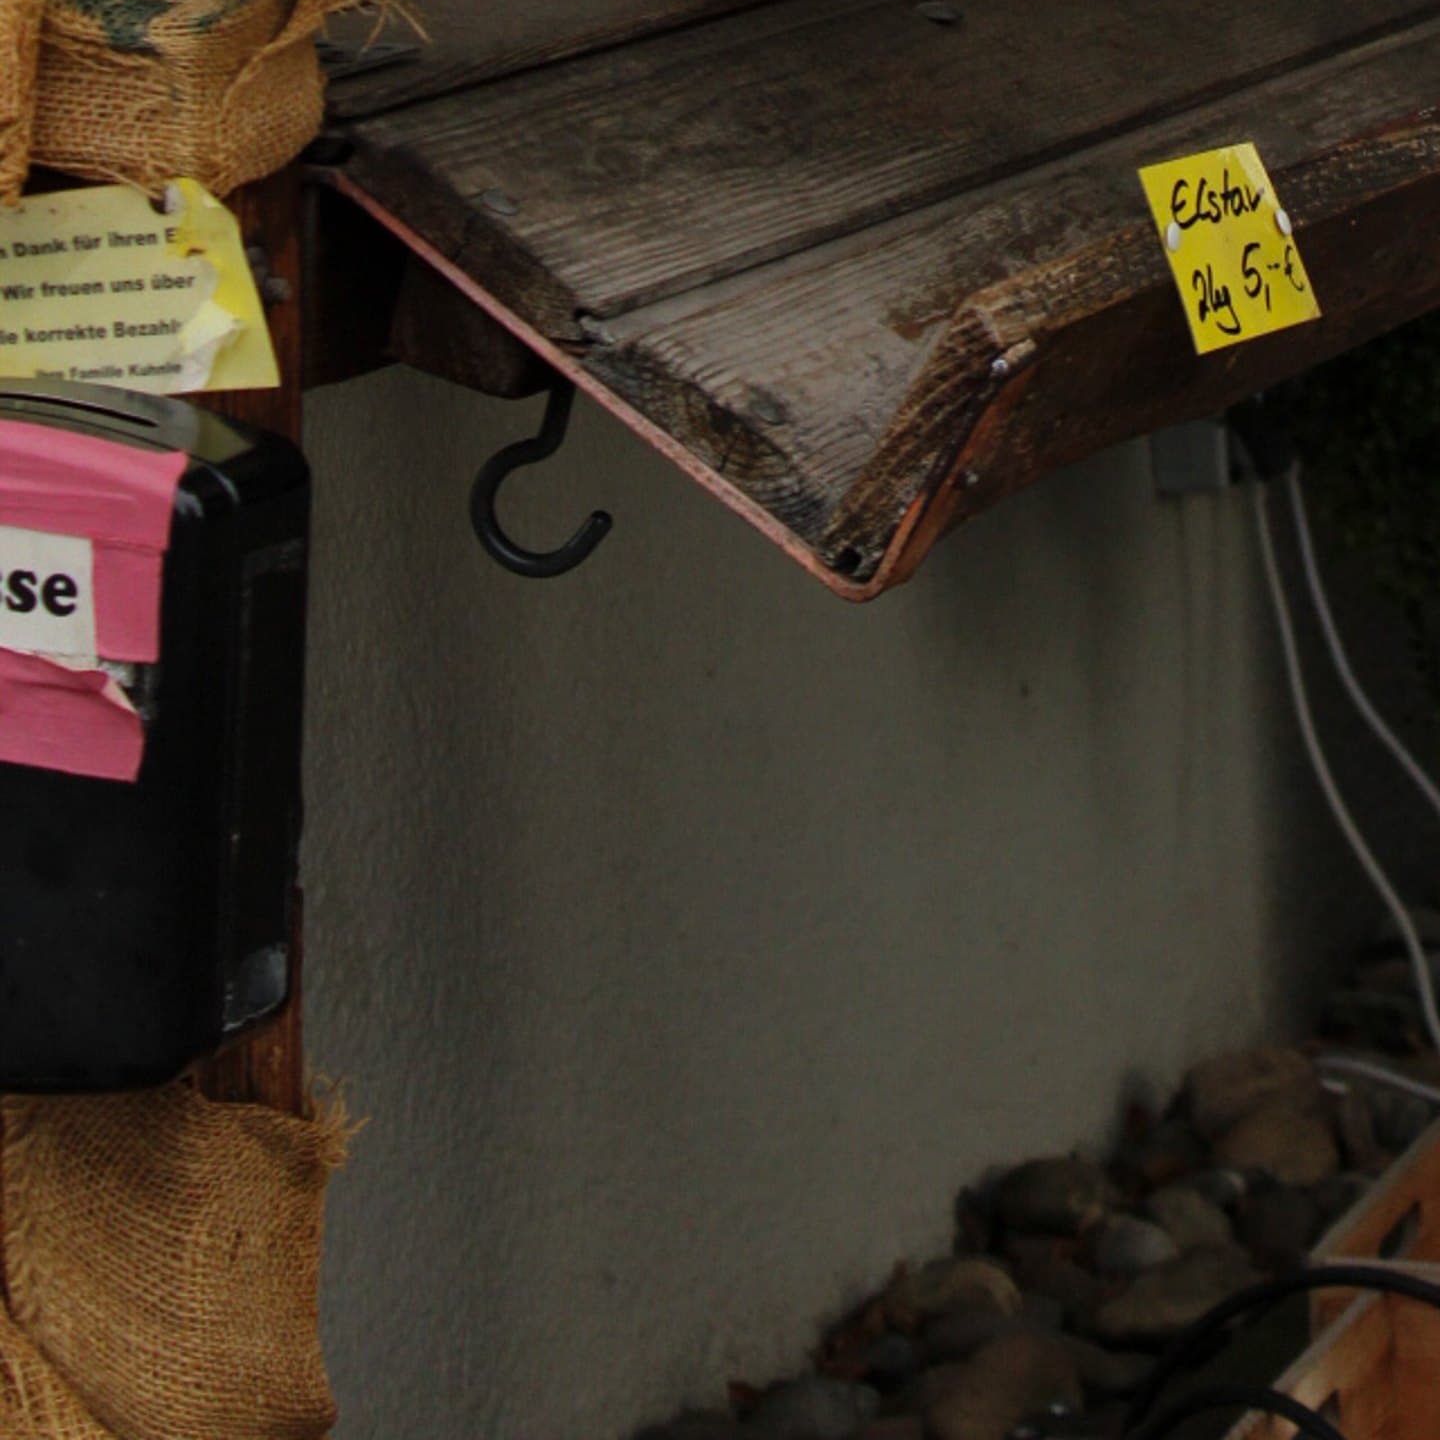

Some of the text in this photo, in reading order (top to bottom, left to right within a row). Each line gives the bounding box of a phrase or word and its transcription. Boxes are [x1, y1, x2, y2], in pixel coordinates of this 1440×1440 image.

[12, 239, 68, 257] Dank
[72, 234, 101, 251] für
[2, 273, 195, 300] Wir freuen uns über
[25, 324, 107, 343] korrekte
[0, 567, 78, 617] se
